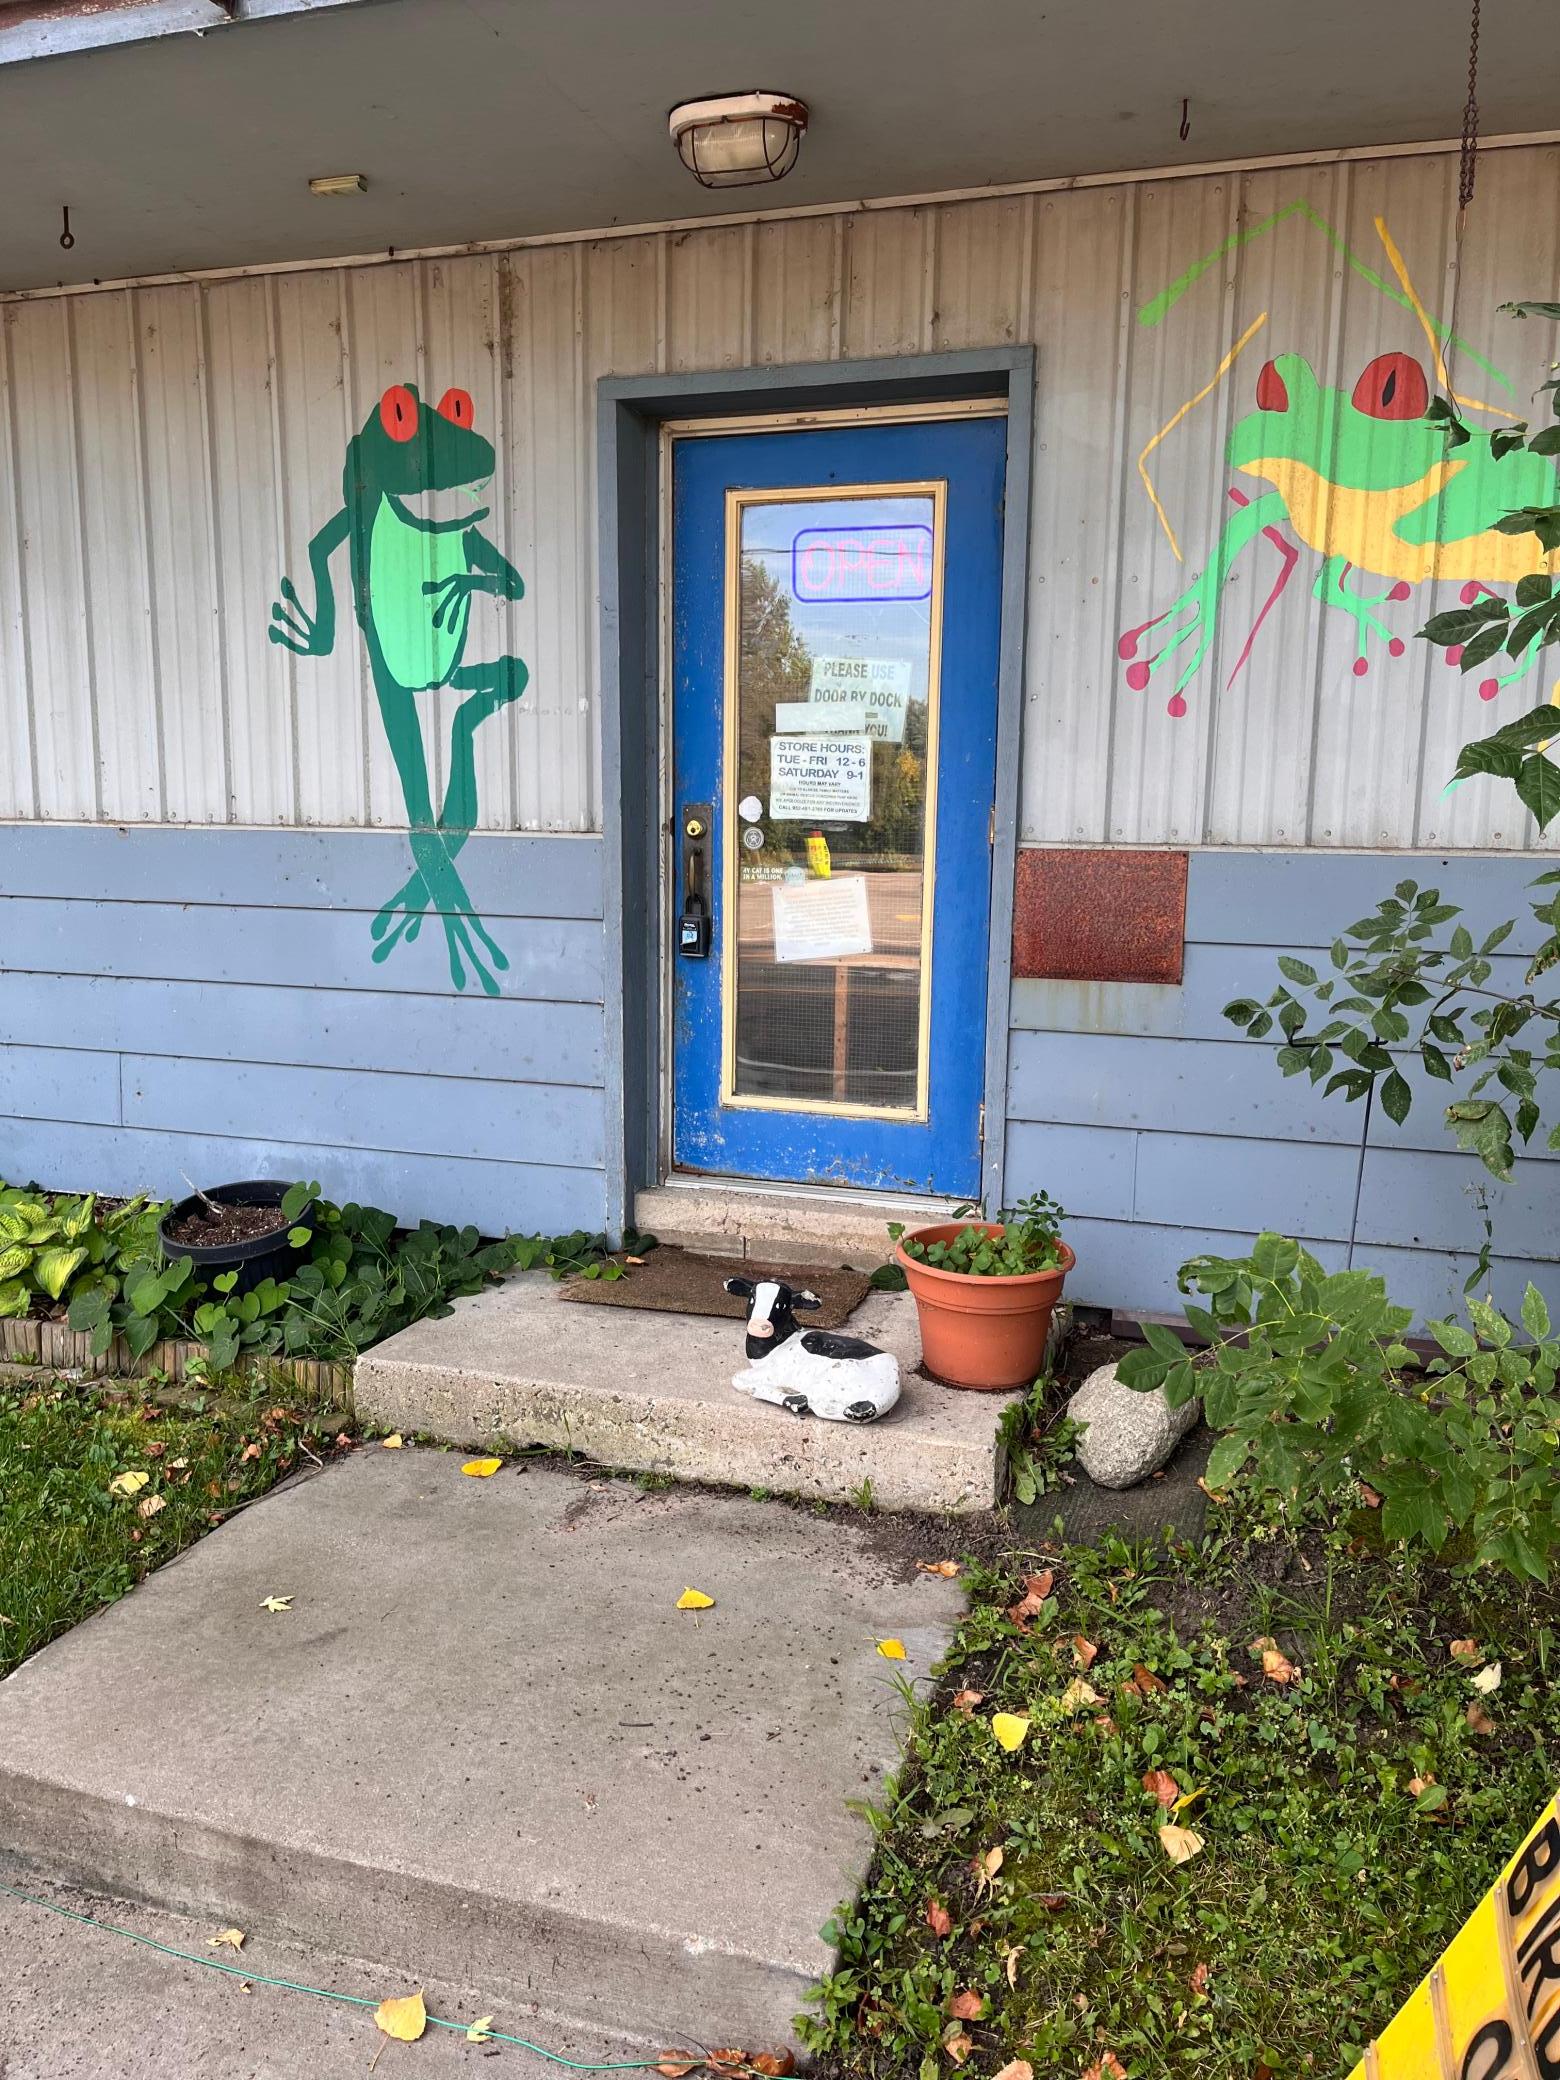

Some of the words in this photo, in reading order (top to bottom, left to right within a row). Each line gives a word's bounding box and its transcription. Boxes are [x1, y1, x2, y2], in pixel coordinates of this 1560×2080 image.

[801, 538, 926, 591] OPEN
[823, 662, 868, 679] PLEASE
[871, 663, 895, 680] USE
[814, 688, 847, 702] DOOR
[869, 691, 902, 707] DOCK
[779, 741, 818, 752] STORE
[820, 743, 865, 754] HOURS:
[777, 754, 801, 764] TUE
[809, 756, 828, 766] FRI
[836, 757, 850, 767] 12
[858, 758, 866, 767] 6
[778, 767, 839, 779] SATURDAY
[846, 770, 863, 780] 9-1
